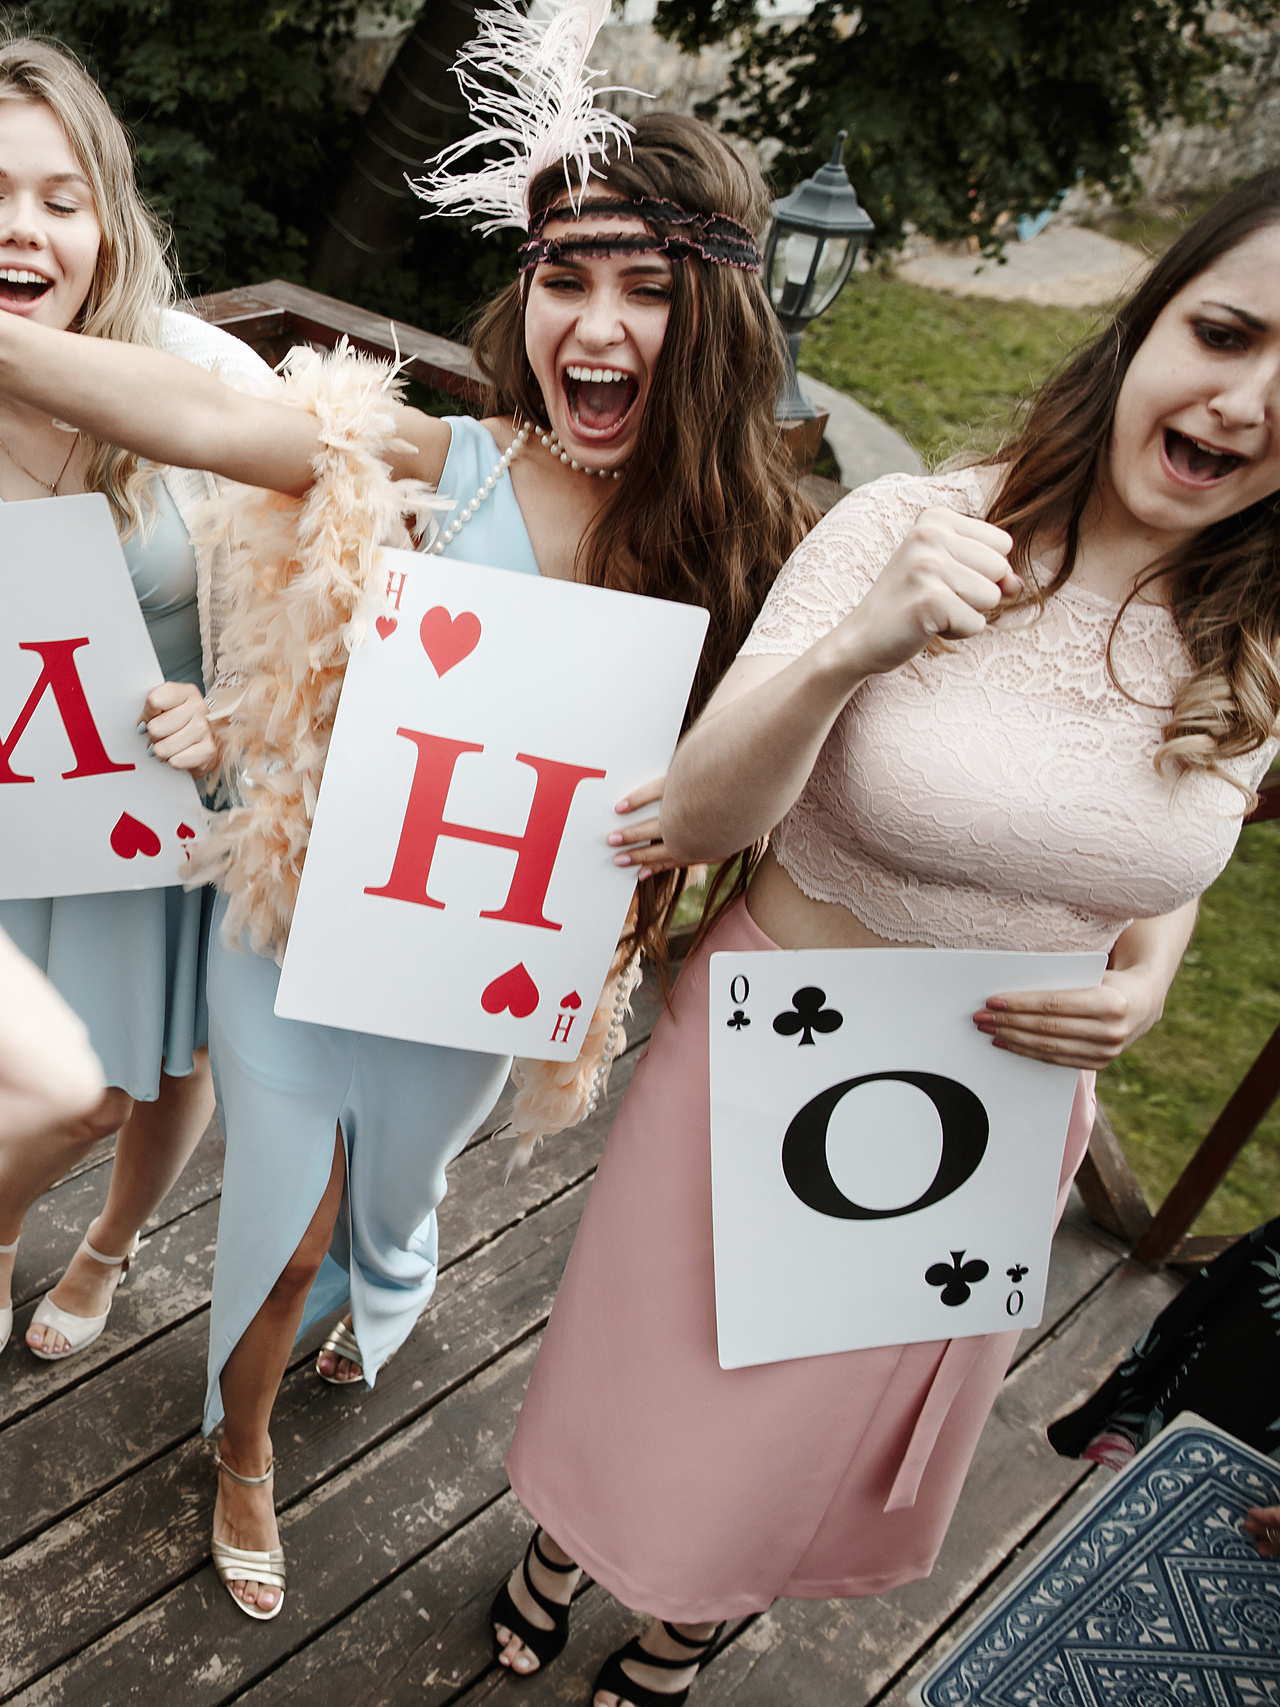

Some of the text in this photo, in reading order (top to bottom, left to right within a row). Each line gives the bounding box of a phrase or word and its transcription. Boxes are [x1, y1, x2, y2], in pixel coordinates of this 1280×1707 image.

[386, 570, 408, 611] Н
[363, 726, 607, 932] Н
[549, 1013, 576, 1044] Н
[781, 1070, 990, 1221] О
